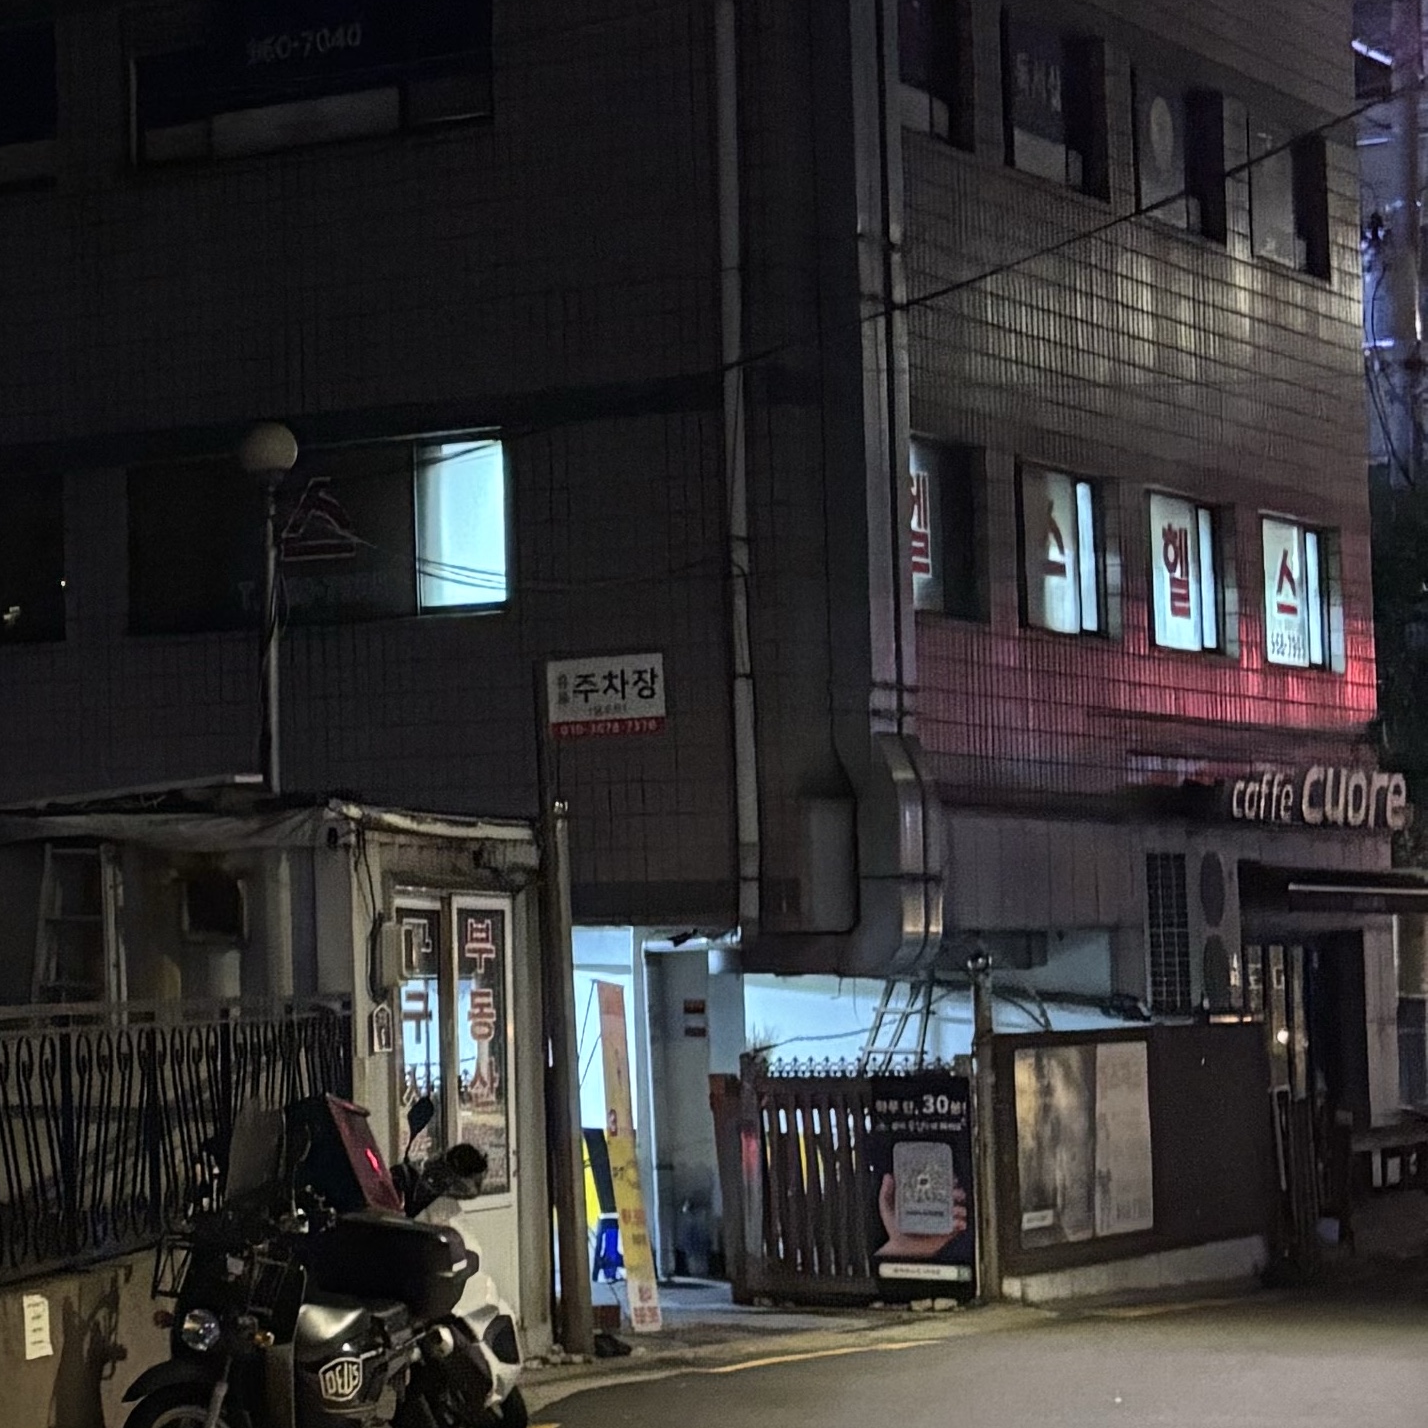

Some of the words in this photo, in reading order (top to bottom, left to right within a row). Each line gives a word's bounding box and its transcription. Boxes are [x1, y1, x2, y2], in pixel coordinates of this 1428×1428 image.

[281, 476, 356, 562] 스
[1162, 523, 1191, 619] 헬
[1276, 549, 1298, 614] 스
[573, 667, 658, 703] 주차장
[465, 918, 499, 1107] 부동산
[325, 1362, 359, 1395] DEUS
